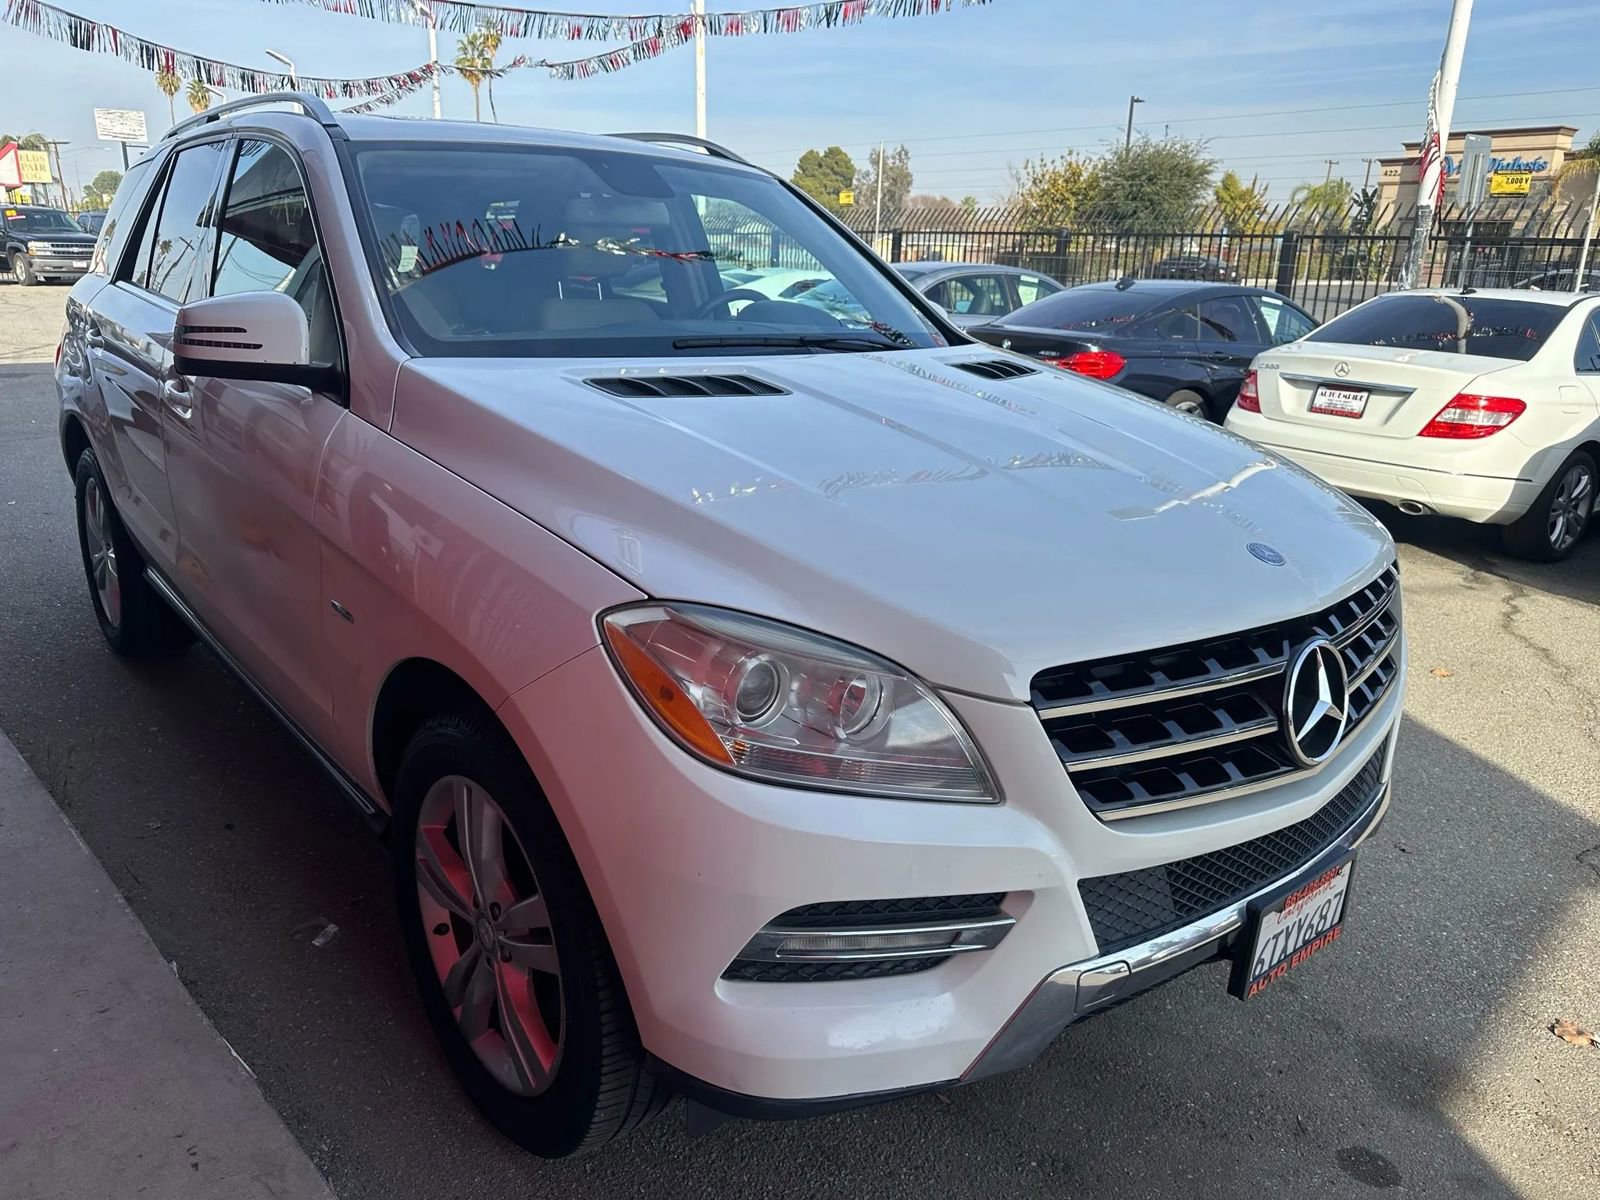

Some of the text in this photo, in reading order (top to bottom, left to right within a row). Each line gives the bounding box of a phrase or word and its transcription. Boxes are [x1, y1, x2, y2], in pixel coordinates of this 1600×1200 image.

[1248, 925, 1343, 999] AUTO EMPIRE
[1252, 889, 1344, 977] 6TXY687
